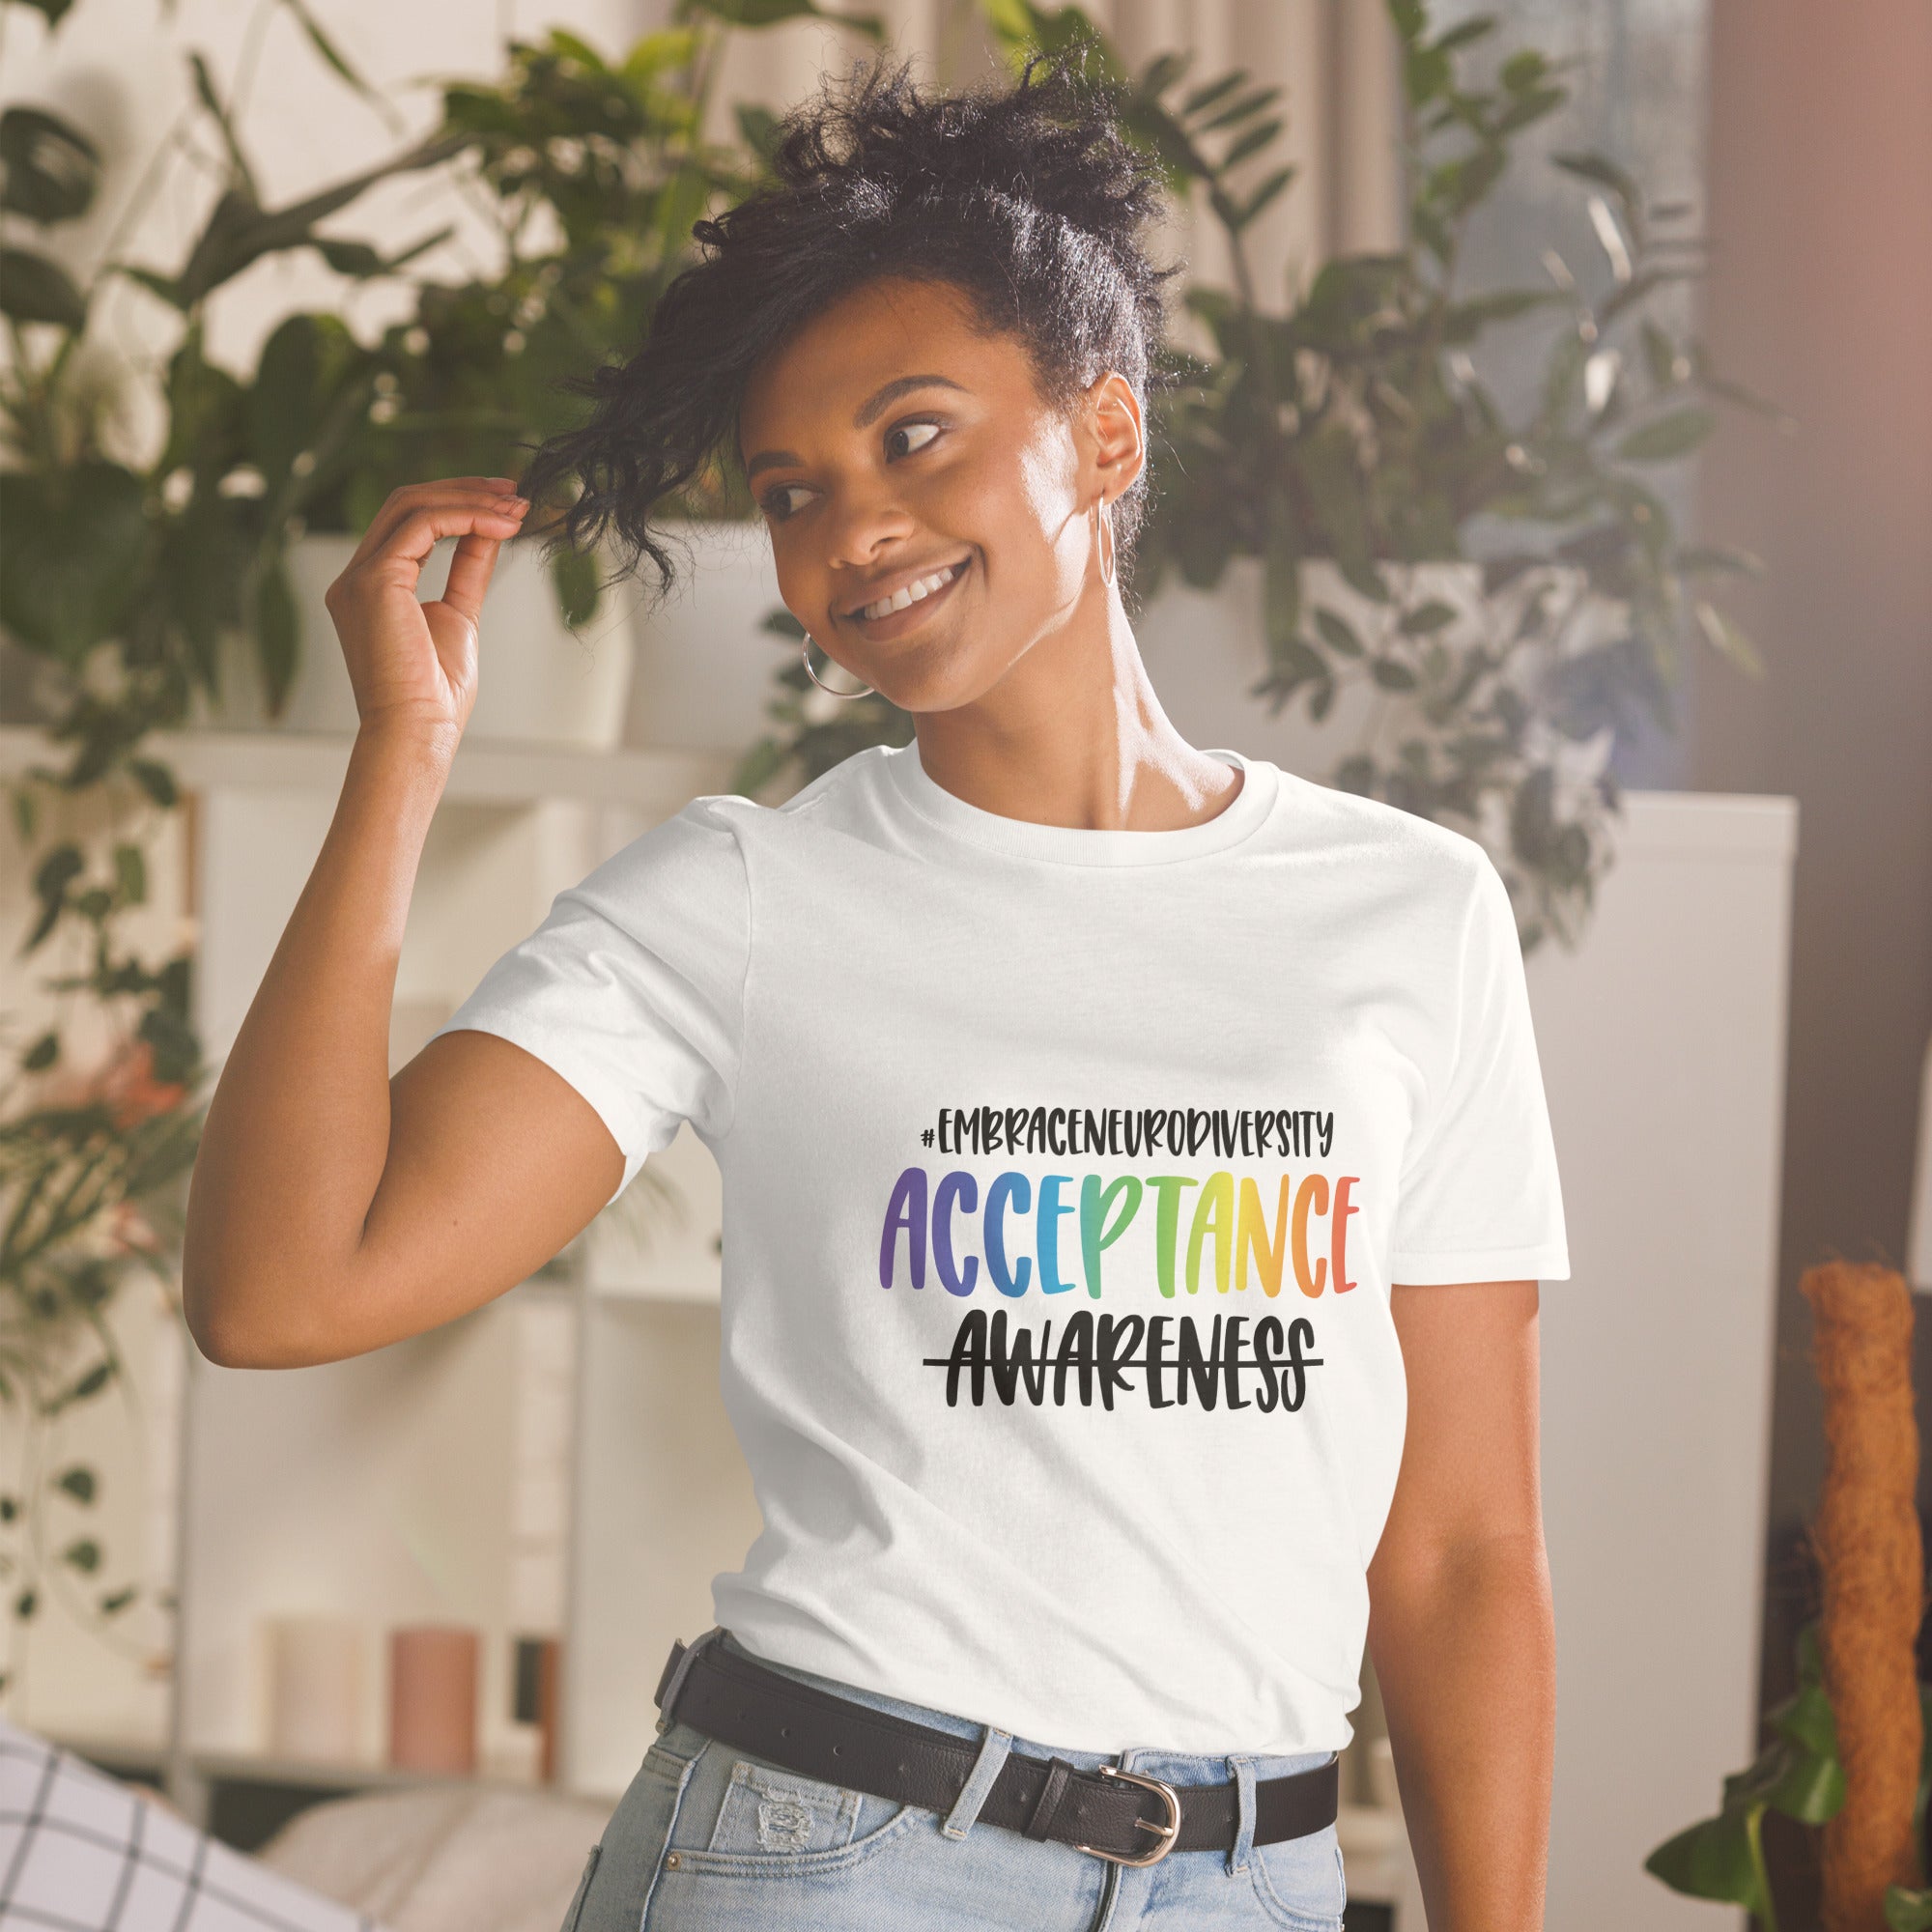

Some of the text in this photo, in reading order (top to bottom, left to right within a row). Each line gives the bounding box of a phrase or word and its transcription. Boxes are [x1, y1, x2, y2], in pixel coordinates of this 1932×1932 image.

[921, 1106, 1334, 1158] #EMBRACENEURODIVERSITY
[879, 1167, 1361, 1299] ACCEPTANCE
[946, 1309, 1316, 1413] AWARENESS
